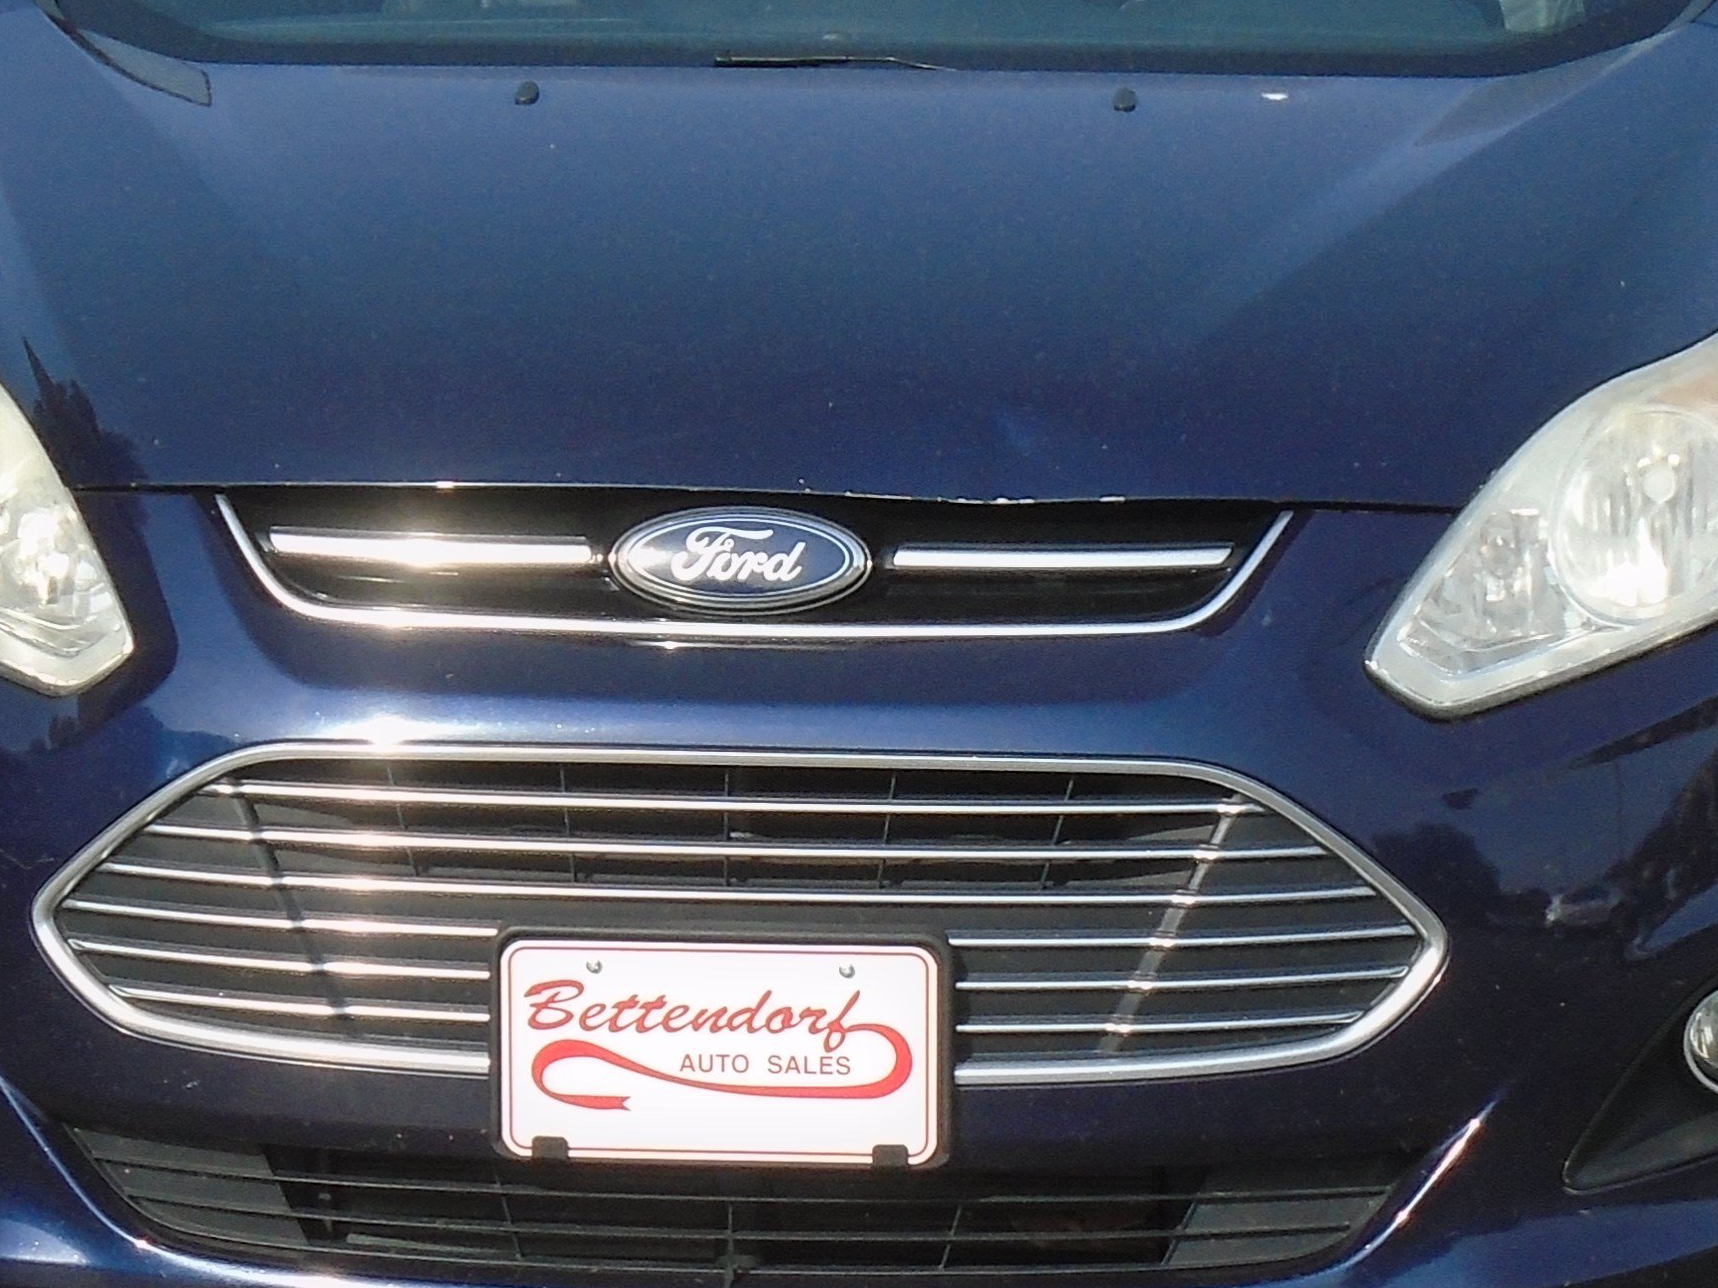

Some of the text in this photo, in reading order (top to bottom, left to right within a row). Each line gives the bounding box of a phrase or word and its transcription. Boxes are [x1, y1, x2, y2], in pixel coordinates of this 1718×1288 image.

[671, 525, 804, 582] Ford
[524, 979, 861, 1051] Bettendorf
[679, 1054, 852, 1076] AUTO SALES
